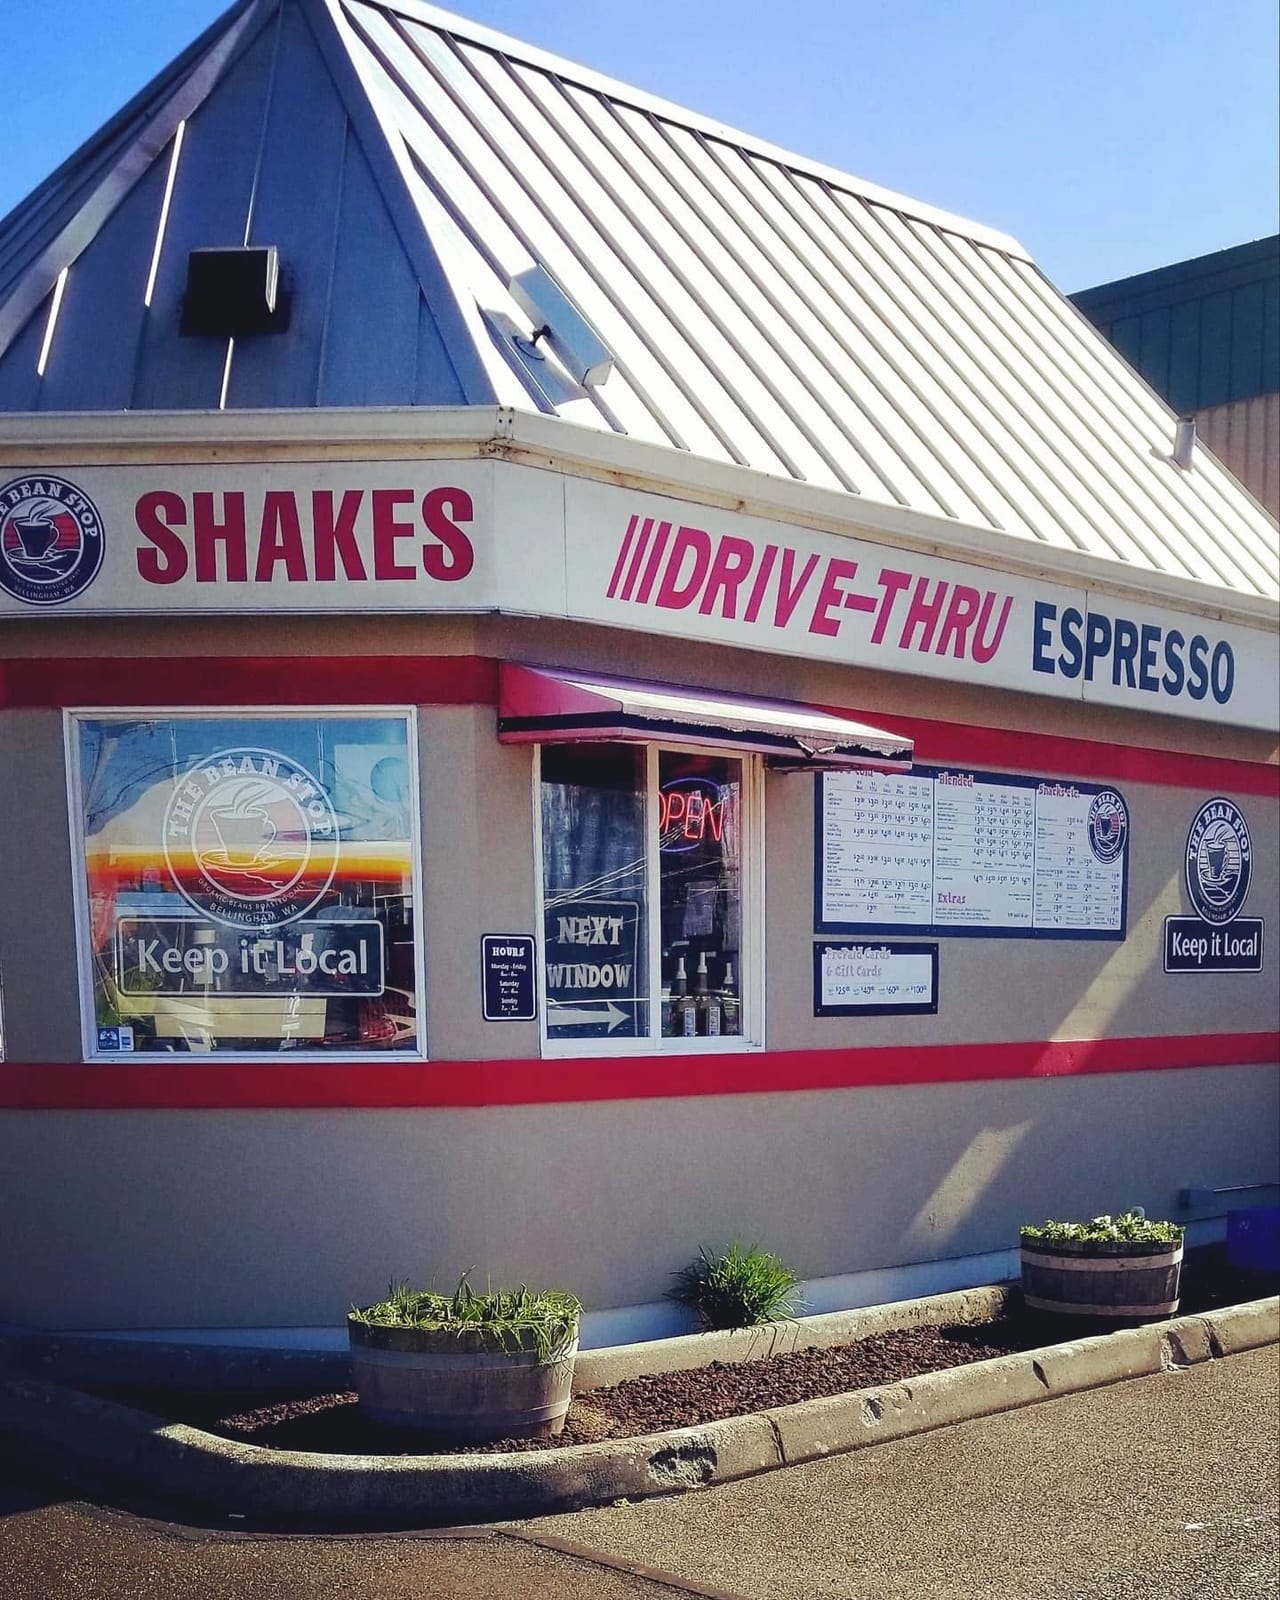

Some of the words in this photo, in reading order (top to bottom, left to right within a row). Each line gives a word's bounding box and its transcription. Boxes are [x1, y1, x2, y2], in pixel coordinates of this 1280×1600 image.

[7, 482, 63, 503] BEAN
[64, 493, 98, 537] STOP
[136, 487, 475, 585] SHAKES
[655, 526, 1015, 665] DRIVE-THRU
[1032, 600, 1235, 705] ESPRESSO
[939, 772, 974, 787] Blended
[1039, 784, 1065, 797] Snacks
[168, 780, 205, 837] THE
[201, 756, 281, 786] BEAN
[285, 772, 332, 836] STOP
[1189, 822, 1204, 861] THE
[1203, 805, 1233, 823] BEAN
[1233, 817, 1249, 862] STOP
[281, 903, 298, 916] WA
[938, 892, 966, 904] Extras
[557, 915, 624, 946] NEXT
[138, 939, 229, 984] Keep
[240, 939, 267, 974] it
[277, 939, 368, 975] Local
[492, 947, 525, 957] HOURS
[864, 947, 890, 960] Cards
[1172, 932, 1208, 964] Keep
[1211, 932, 1223, 956] it
[1224, 931, 1257, 957] Local
[546, 963, 632, 988] WINDOW
[835, 964, 854, 977] Gift
[857, 965, 882, 977] Cards
